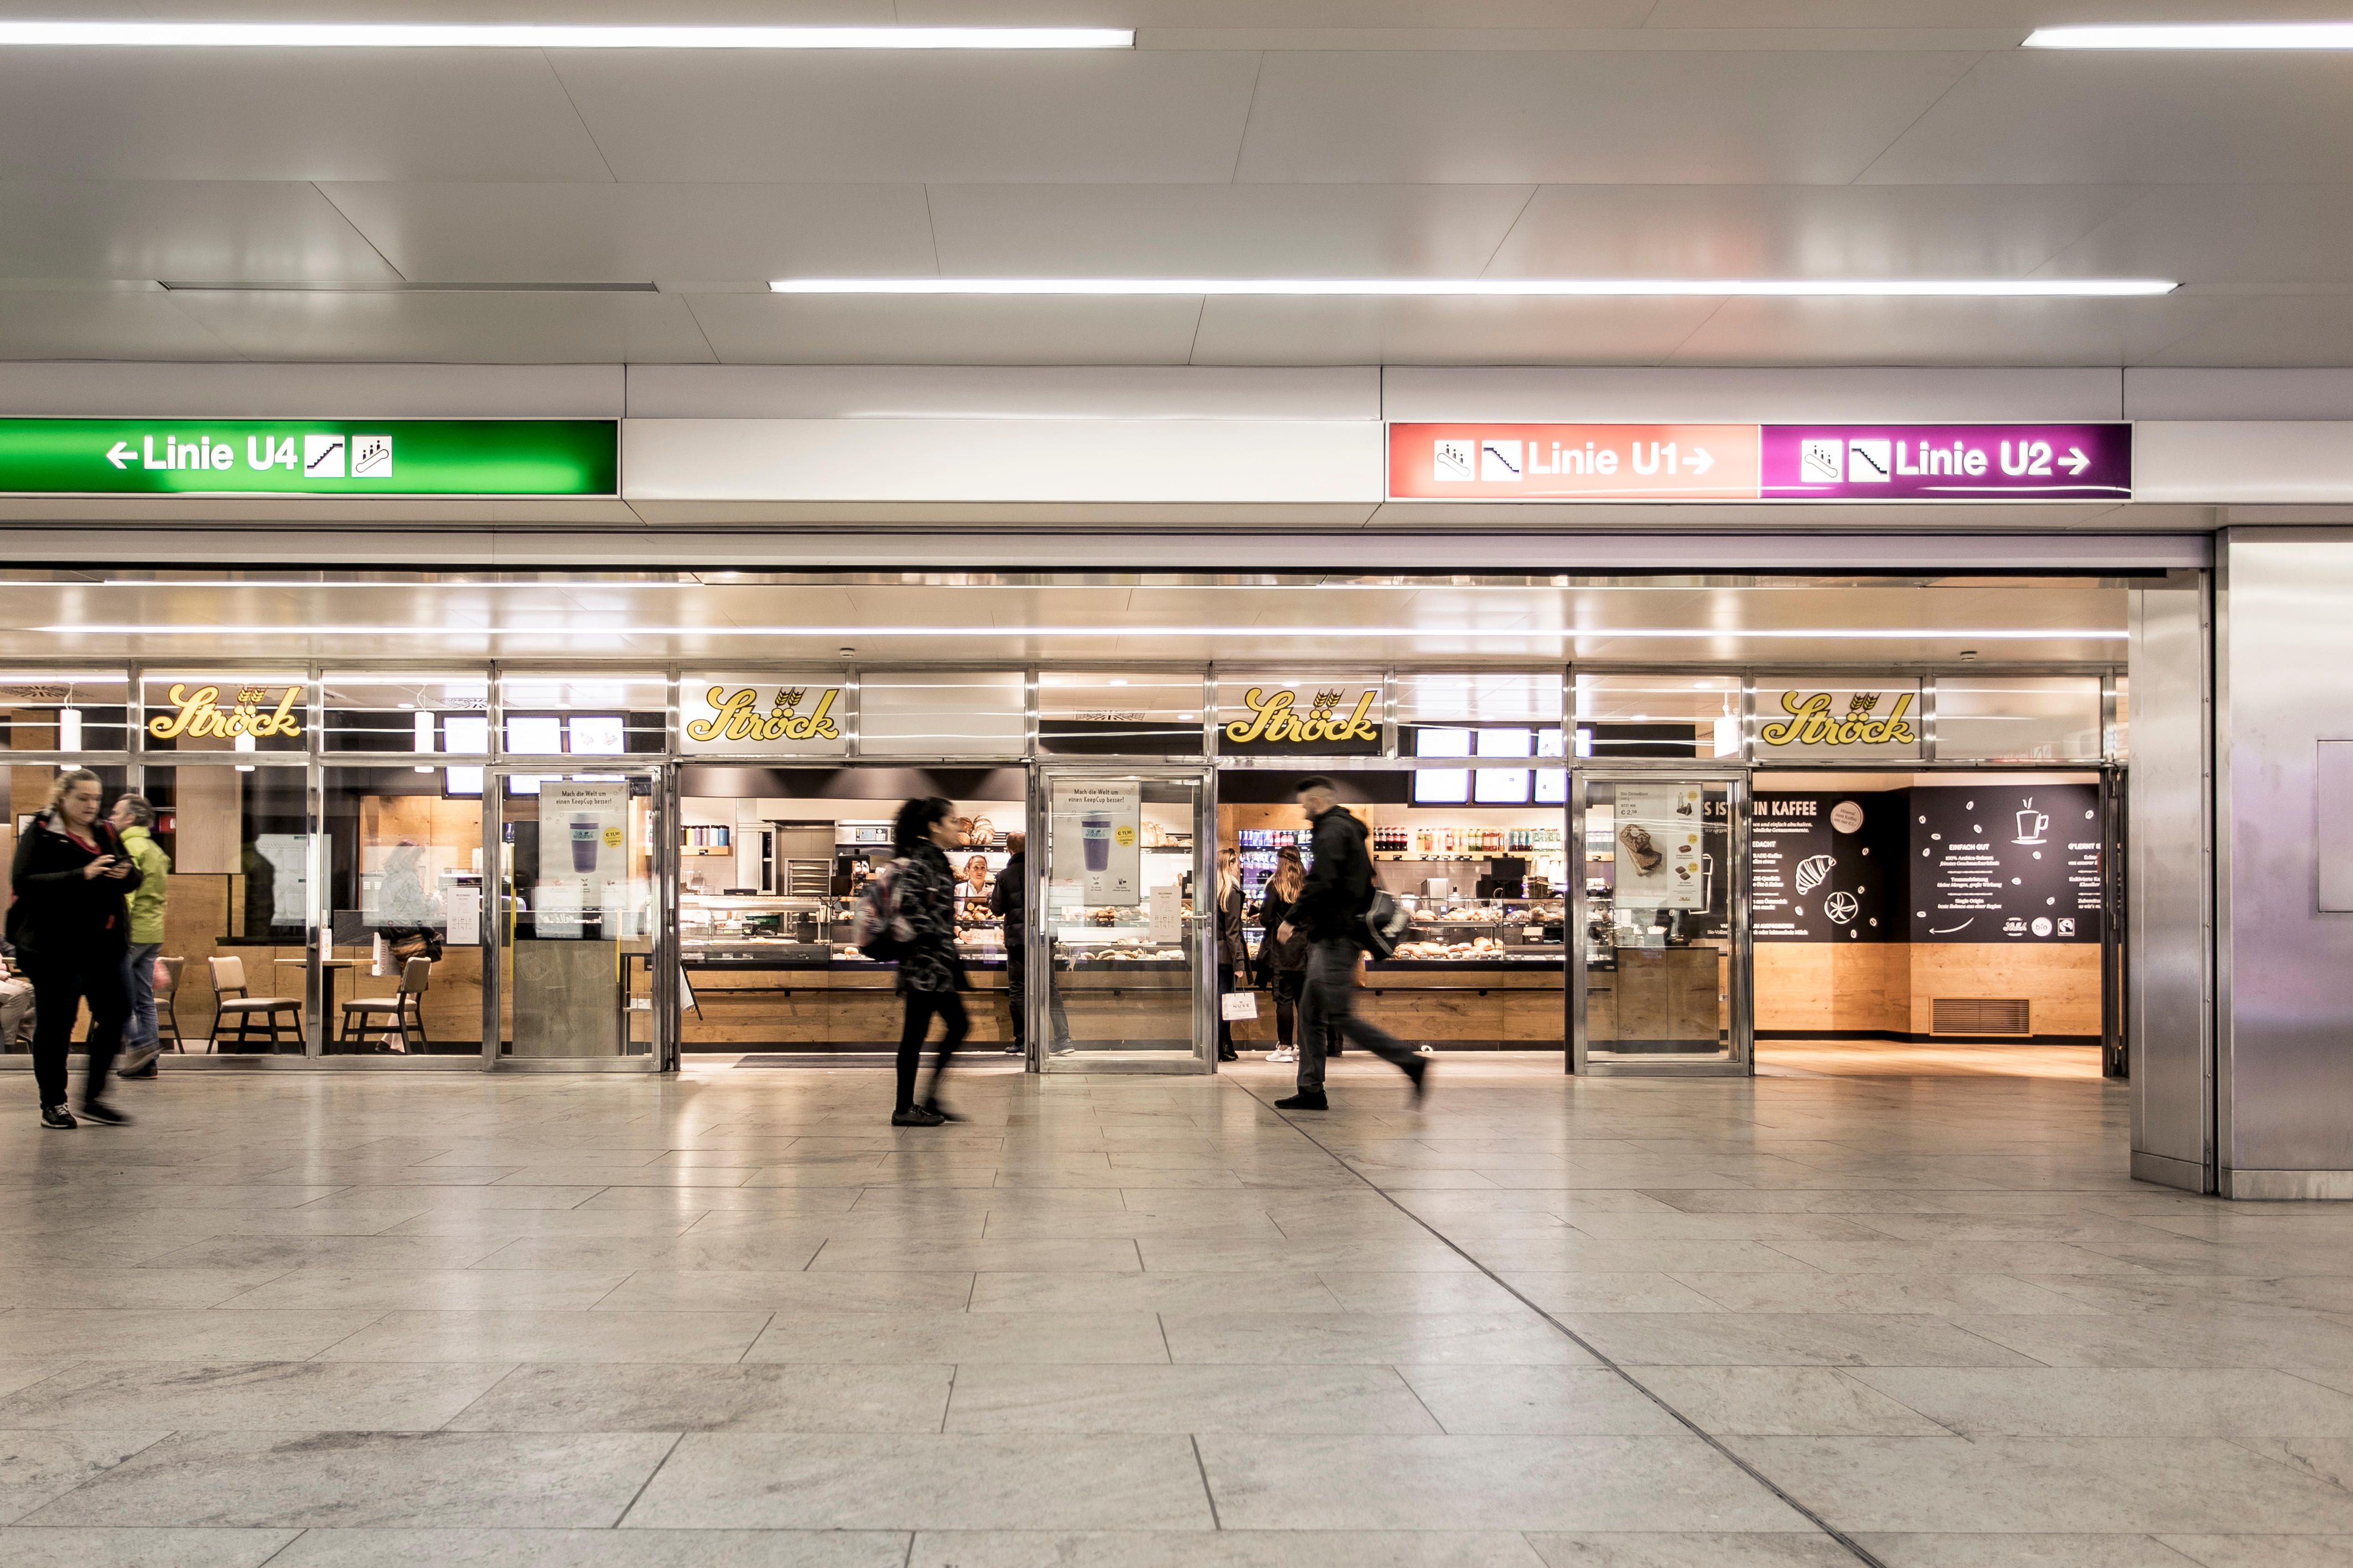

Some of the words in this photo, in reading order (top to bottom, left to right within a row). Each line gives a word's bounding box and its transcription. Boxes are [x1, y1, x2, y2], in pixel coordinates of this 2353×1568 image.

[143, 435, 234, 470] Linie
[247, 435, 298, 470] U4
[1528, 441, 1618, 475] Linie
[1632, 442, 1677, 475] U1
[1896, 441, 1988, 476] Linie
[2000, 441, 2053, 476] U2
[149, 683, 302, 739] Ströck
[687, 686, 840, 741] Ströck
[1226, 688, 1378, 743] Ströck
[1761, 690, 1915, 746] Ströck
[1703, 801, 1712, 815] S
[1753, 801, 1767, 815] IN
[1772, 801, 1817, 815] KAFFEE
